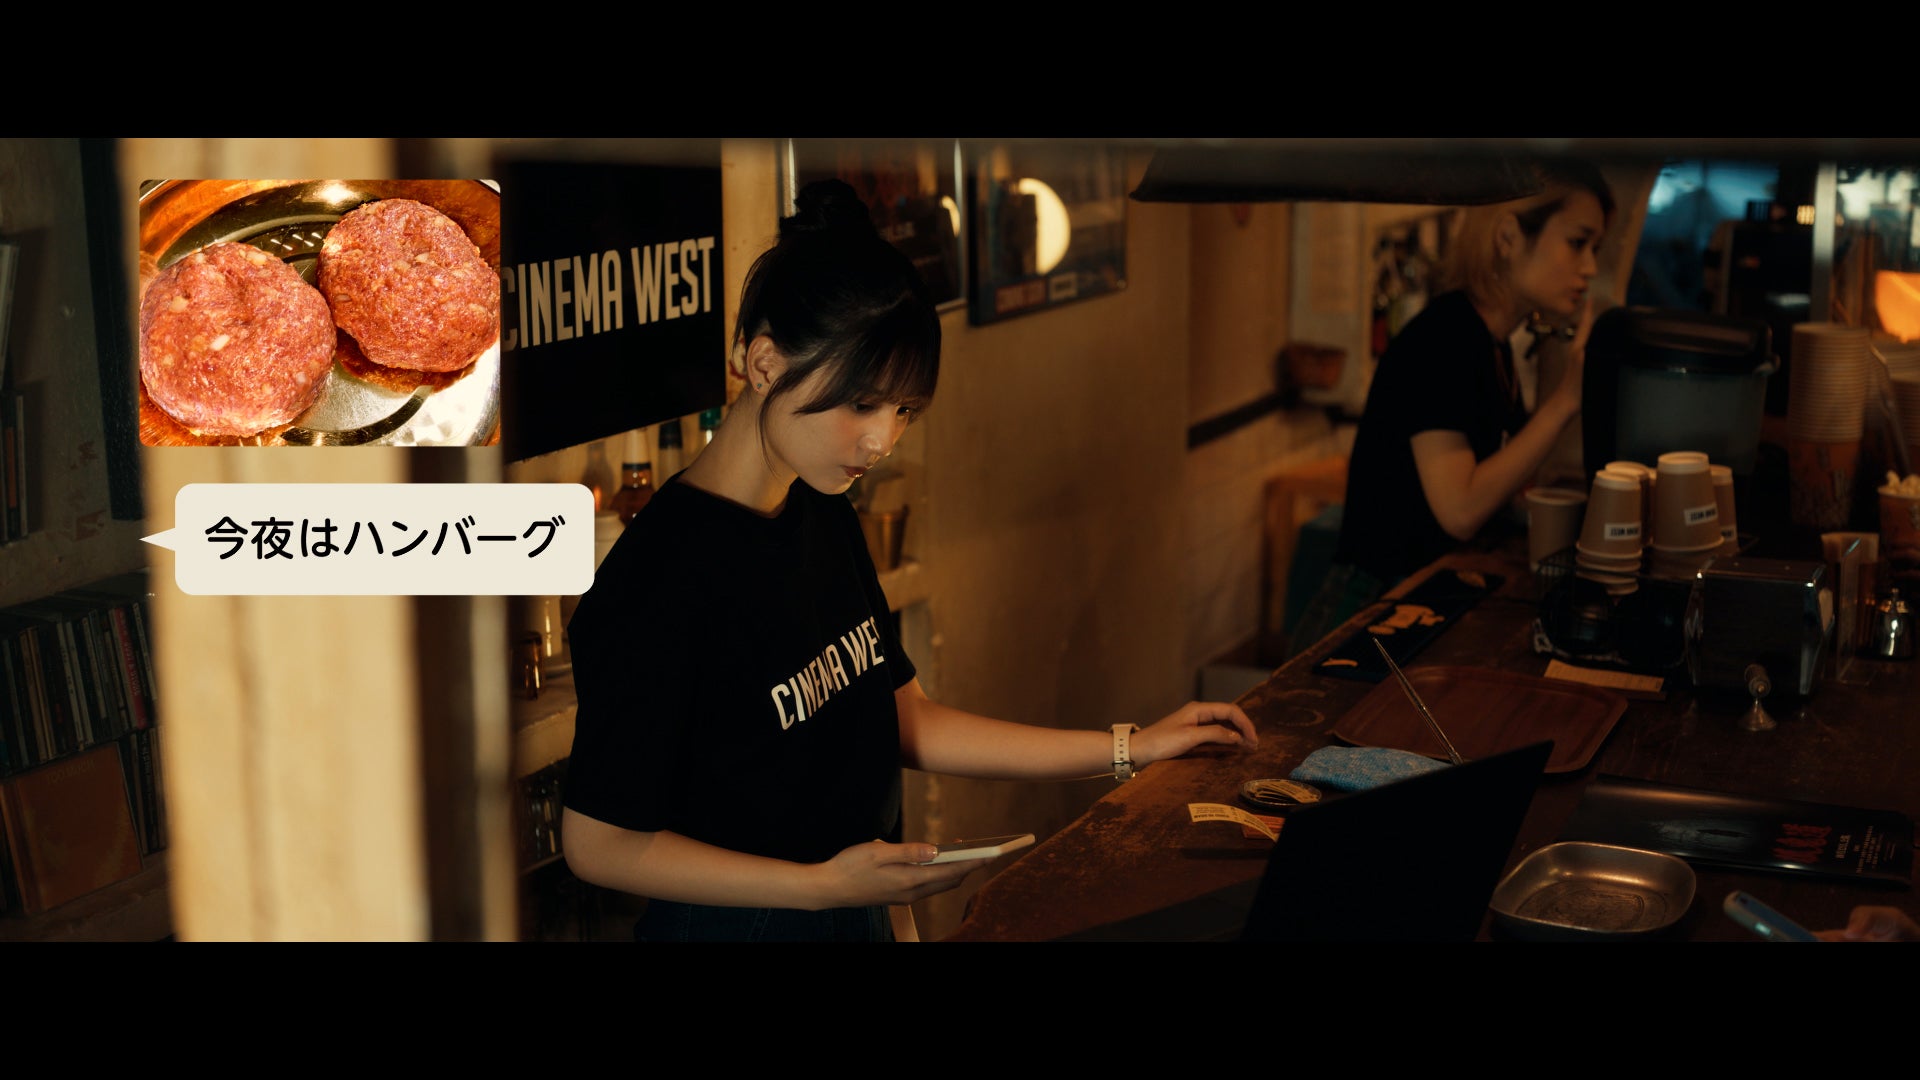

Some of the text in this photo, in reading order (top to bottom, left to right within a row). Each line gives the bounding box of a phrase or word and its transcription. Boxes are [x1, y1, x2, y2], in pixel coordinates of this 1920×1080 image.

[501, 235, 716, 353] CINEMA WEST
[770, 616, 885, 731] CINEMA WE
